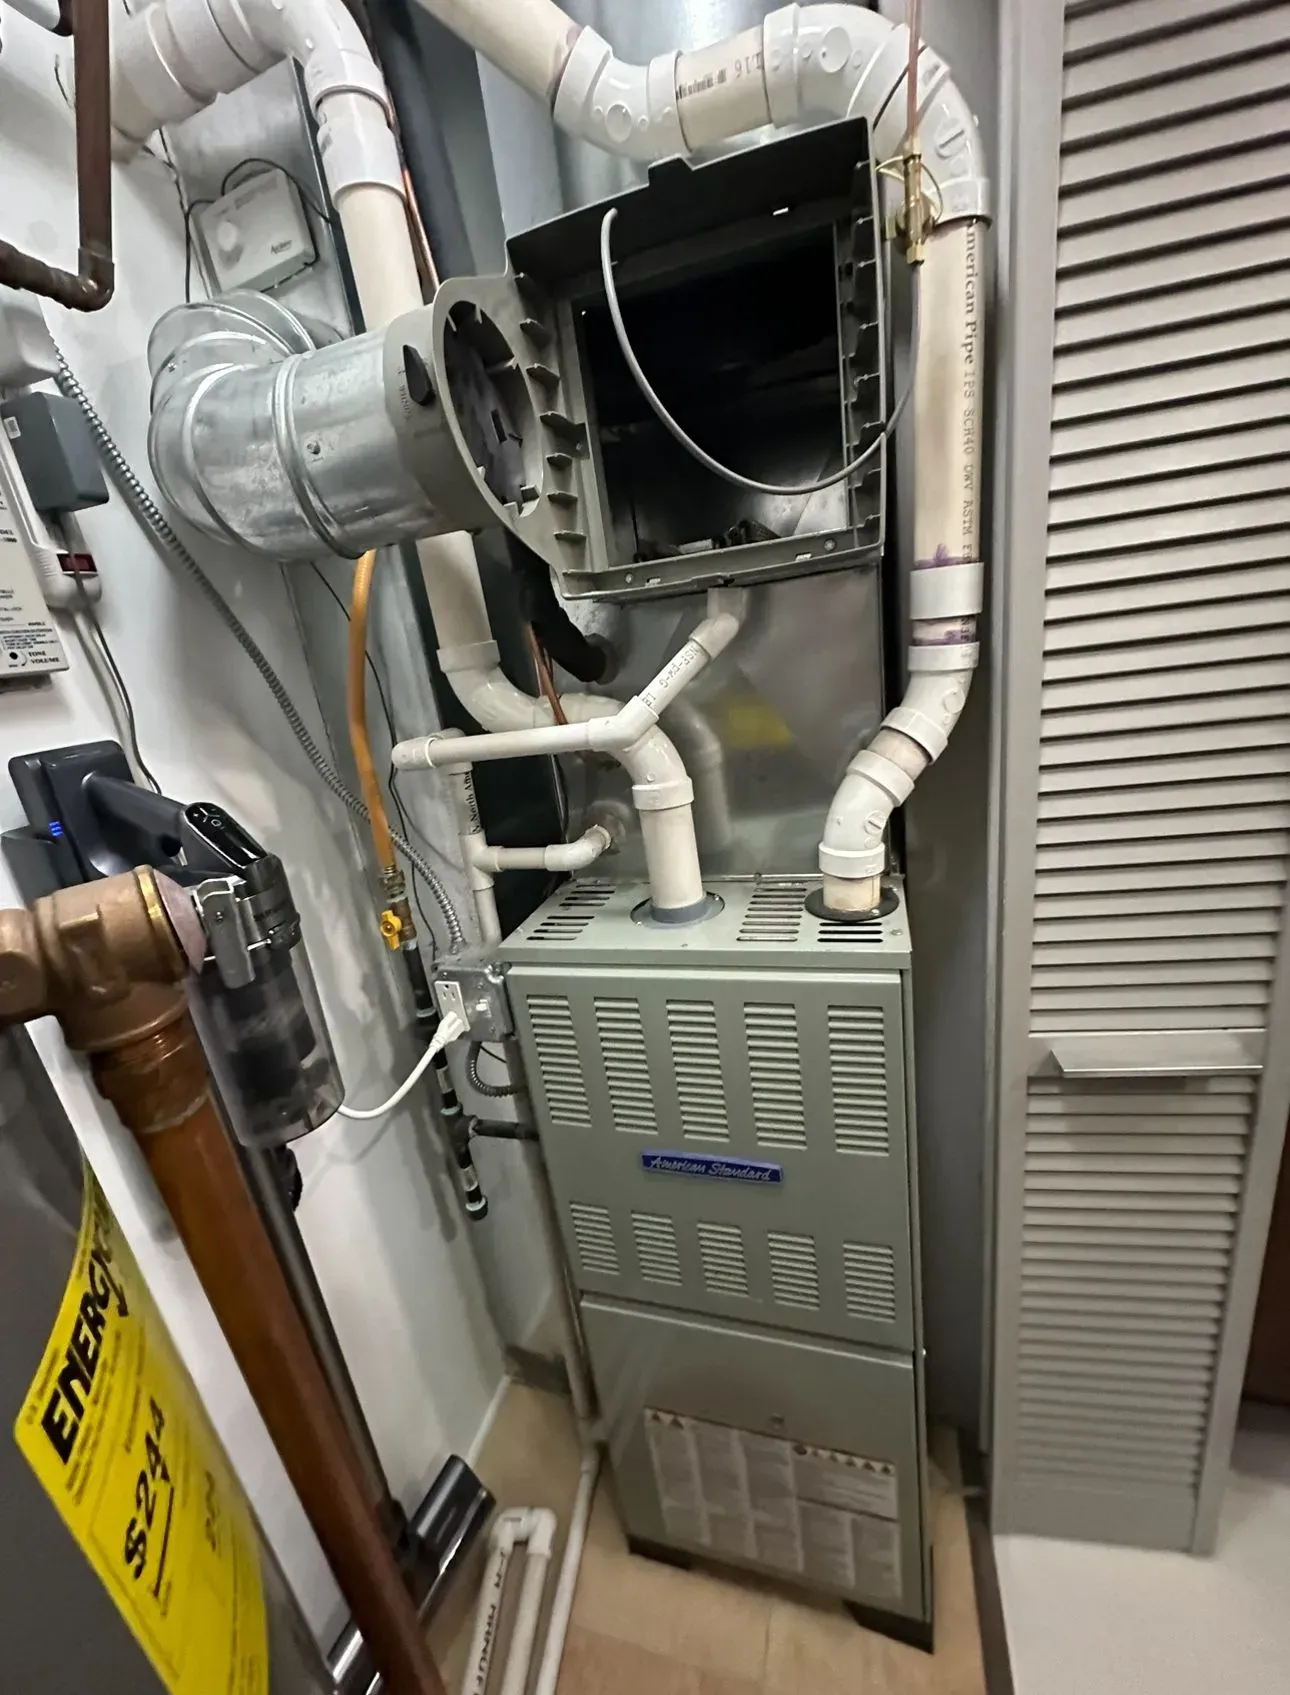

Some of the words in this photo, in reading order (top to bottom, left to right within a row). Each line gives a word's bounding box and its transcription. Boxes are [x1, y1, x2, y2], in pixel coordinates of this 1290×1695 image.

[964, 223, 979, 314] merican
[960, 320, 978, 365] Pipe
[961, 500, 974, 536] ASTM
[31, 656, 60, 664] VOLUME
[465, 793, 480, 822] North
[650, 1155, 706, 1174] American
[708, 1161, 772, 1181] Standard
